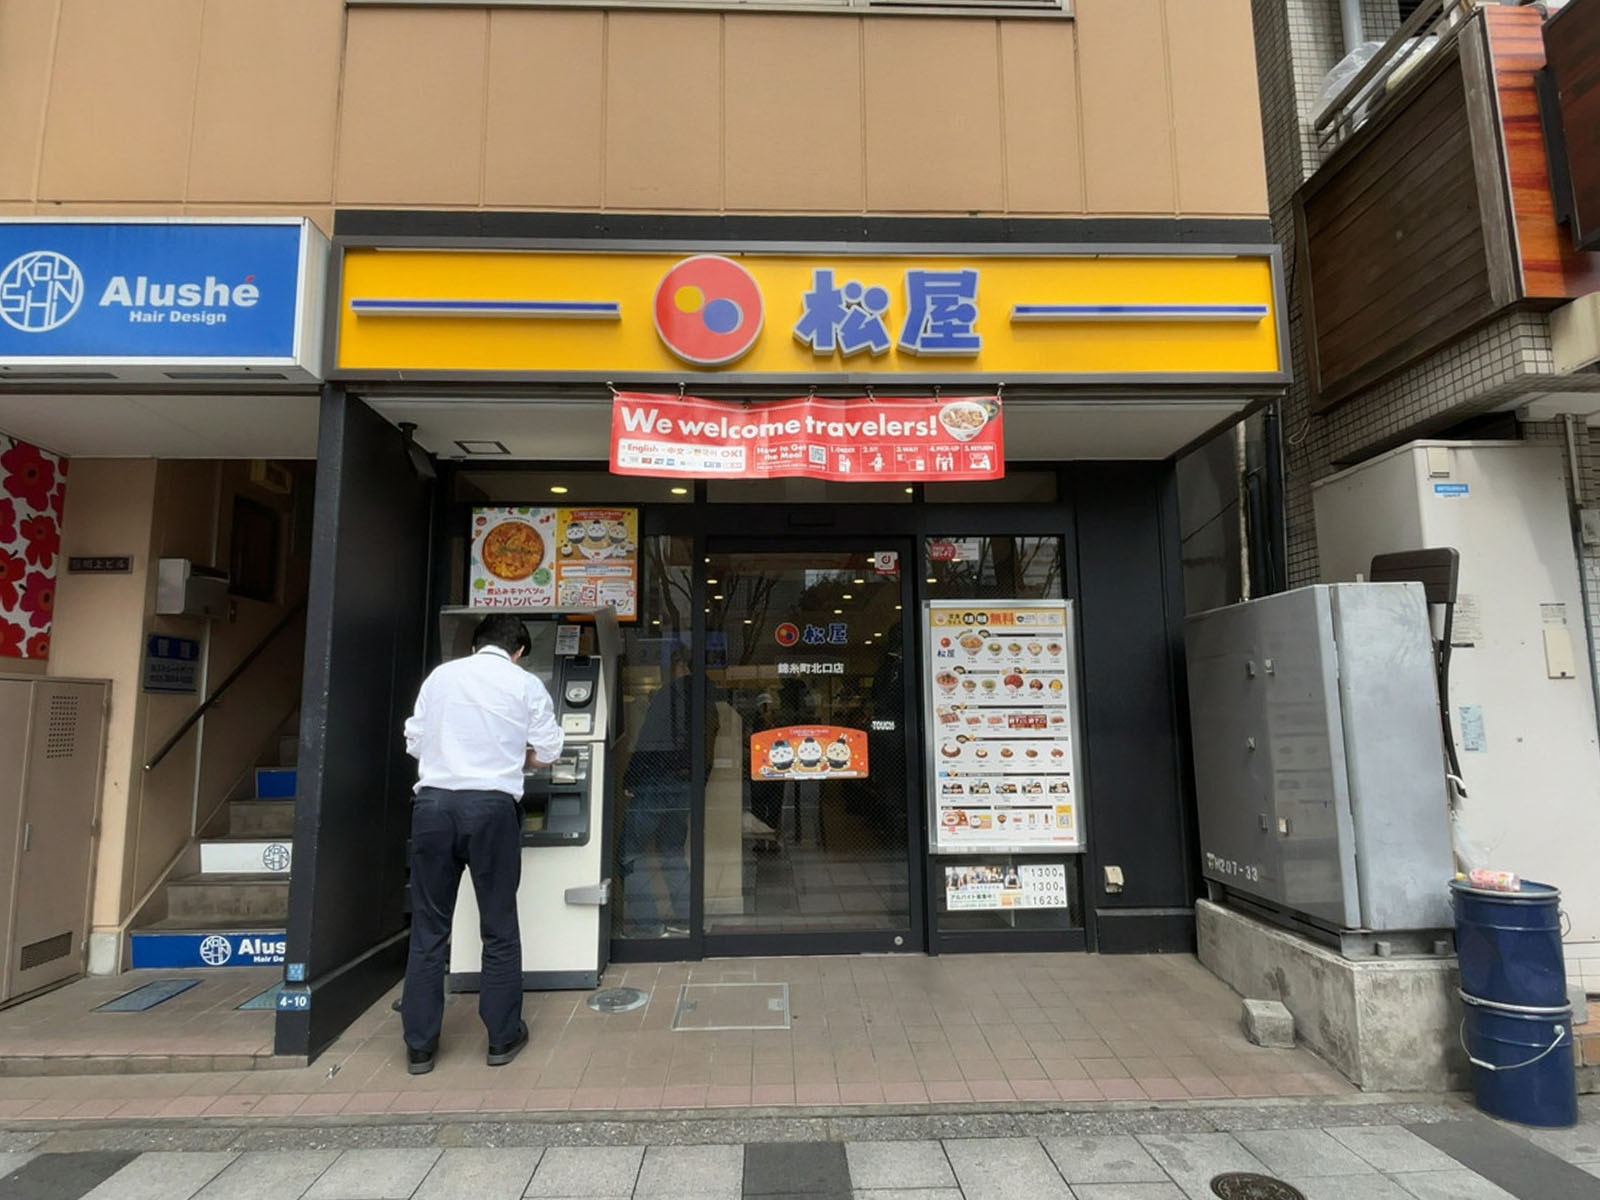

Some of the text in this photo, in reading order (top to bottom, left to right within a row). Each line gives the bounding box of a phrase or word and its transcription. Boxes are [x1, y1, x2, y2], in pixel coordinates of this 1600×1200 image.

[99, 275, 259, 308] Alushé
[129, 311, 226, 325] Hair Design
[793, 267, 982, 357] 松屋
[620, 406, 938, 439] We welcome travelers!
[720, 450, 743, 458] OK!
[802, 623, 848, 645] 松屋
[777, 662, 844, 675] 錦糸町北口店
[253, 955, 271, 963] Hair
[280, 996, 307, 1007] 4-10
